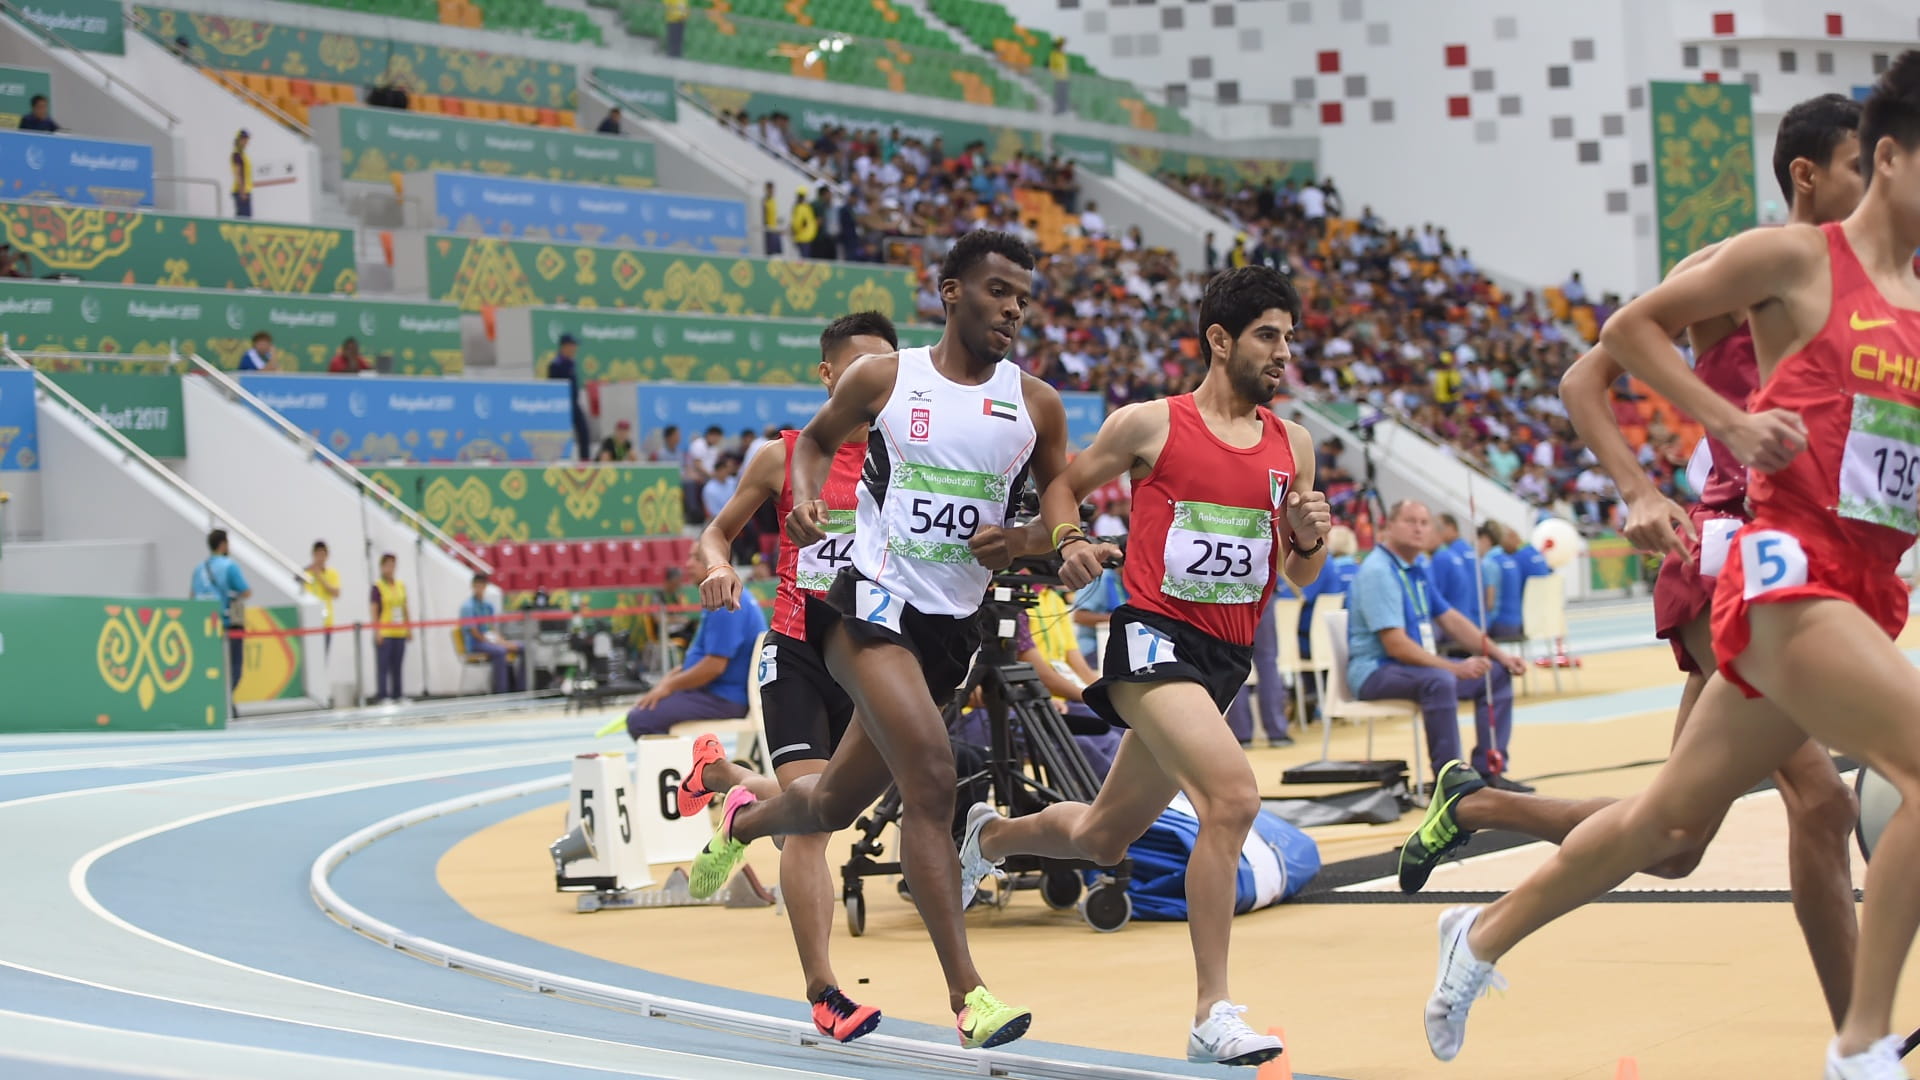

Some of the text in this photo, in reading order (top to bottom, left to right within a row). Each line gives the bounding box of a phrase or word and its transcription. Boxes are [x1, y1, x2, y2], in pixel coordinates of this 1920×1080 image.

[134, 407, 168, 430] 2017
[920, 472, 977, 488] Ashgabat 2017
[910, 498, 980, 541] 549
[1198, 512, 1250, 527] Ashgabat 2017
[1186, 539, 1252, 577] 253
[1756, 539, 1787, 586] 5
[867, 588, 891, 623] 2
[1138, 628, 1160, 663] 7
[658, 768, 681, 820] 6
[580, 790, 595, 838] 5
[615, 788, 631, 844] 5
